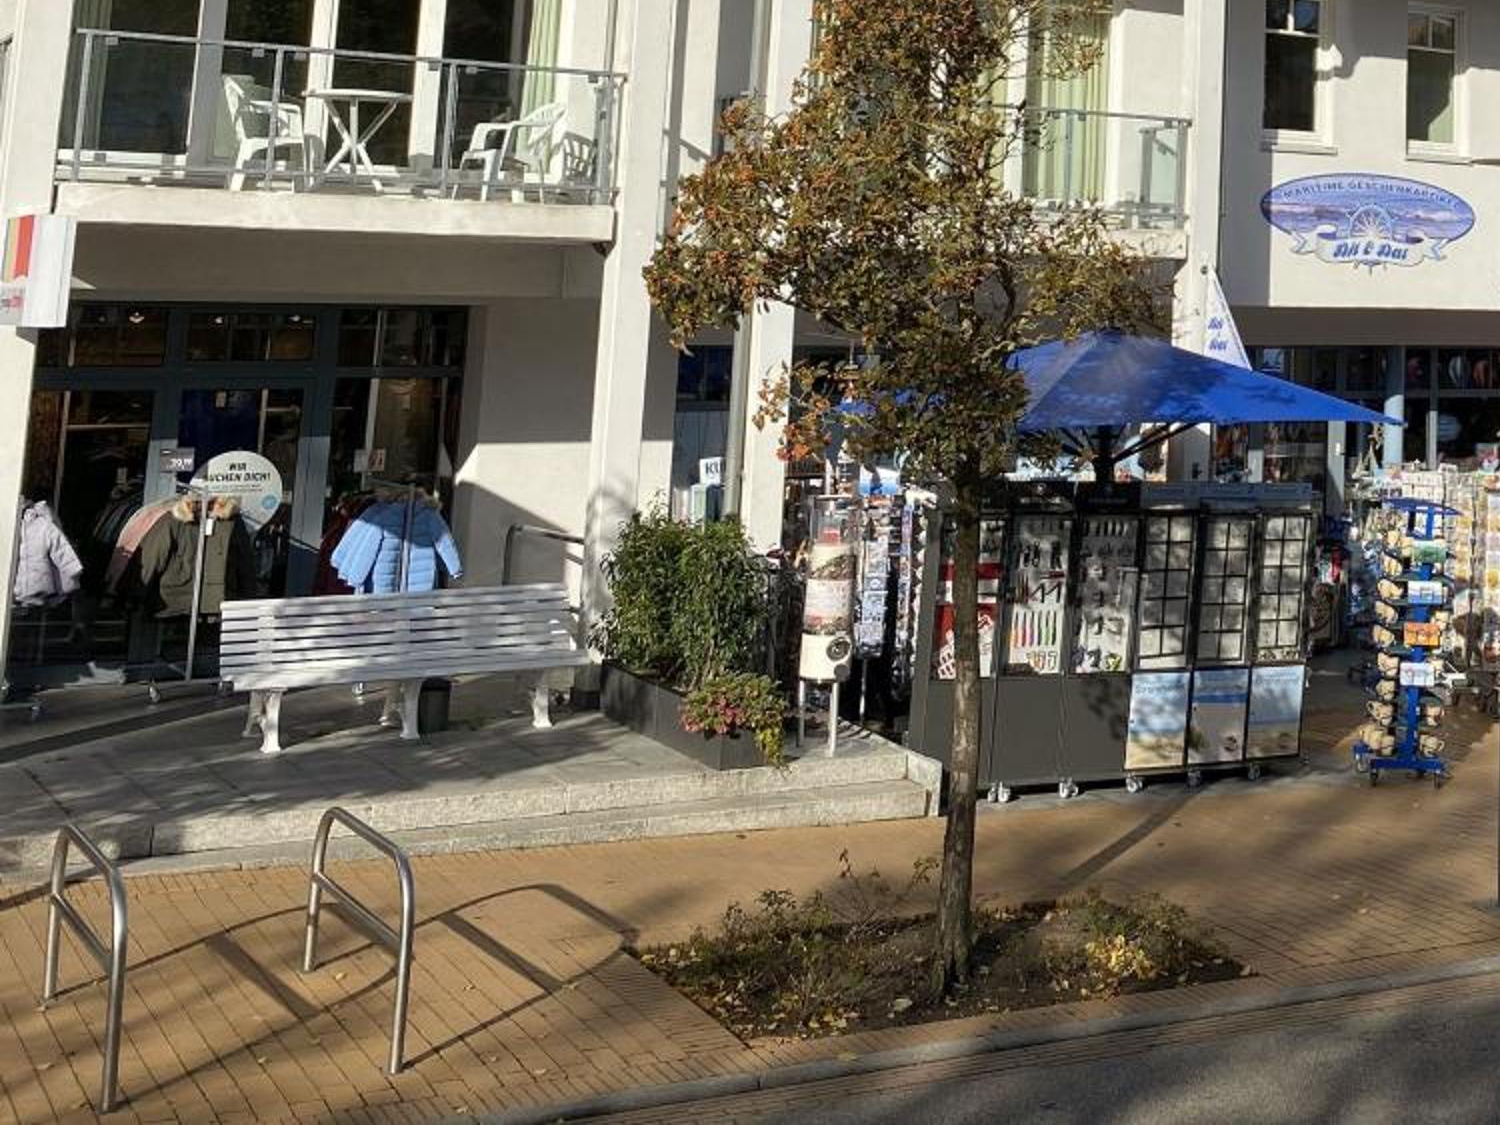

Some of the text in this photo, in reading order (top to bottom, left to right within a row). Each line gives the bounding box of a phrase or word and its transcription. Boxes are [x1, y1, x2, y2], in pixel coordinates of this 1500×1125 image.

[1283, 181, 1345, 199] MARITIME
[229, 462, 247, 471] WIR
[243, 471, 271, 482] DICH!
